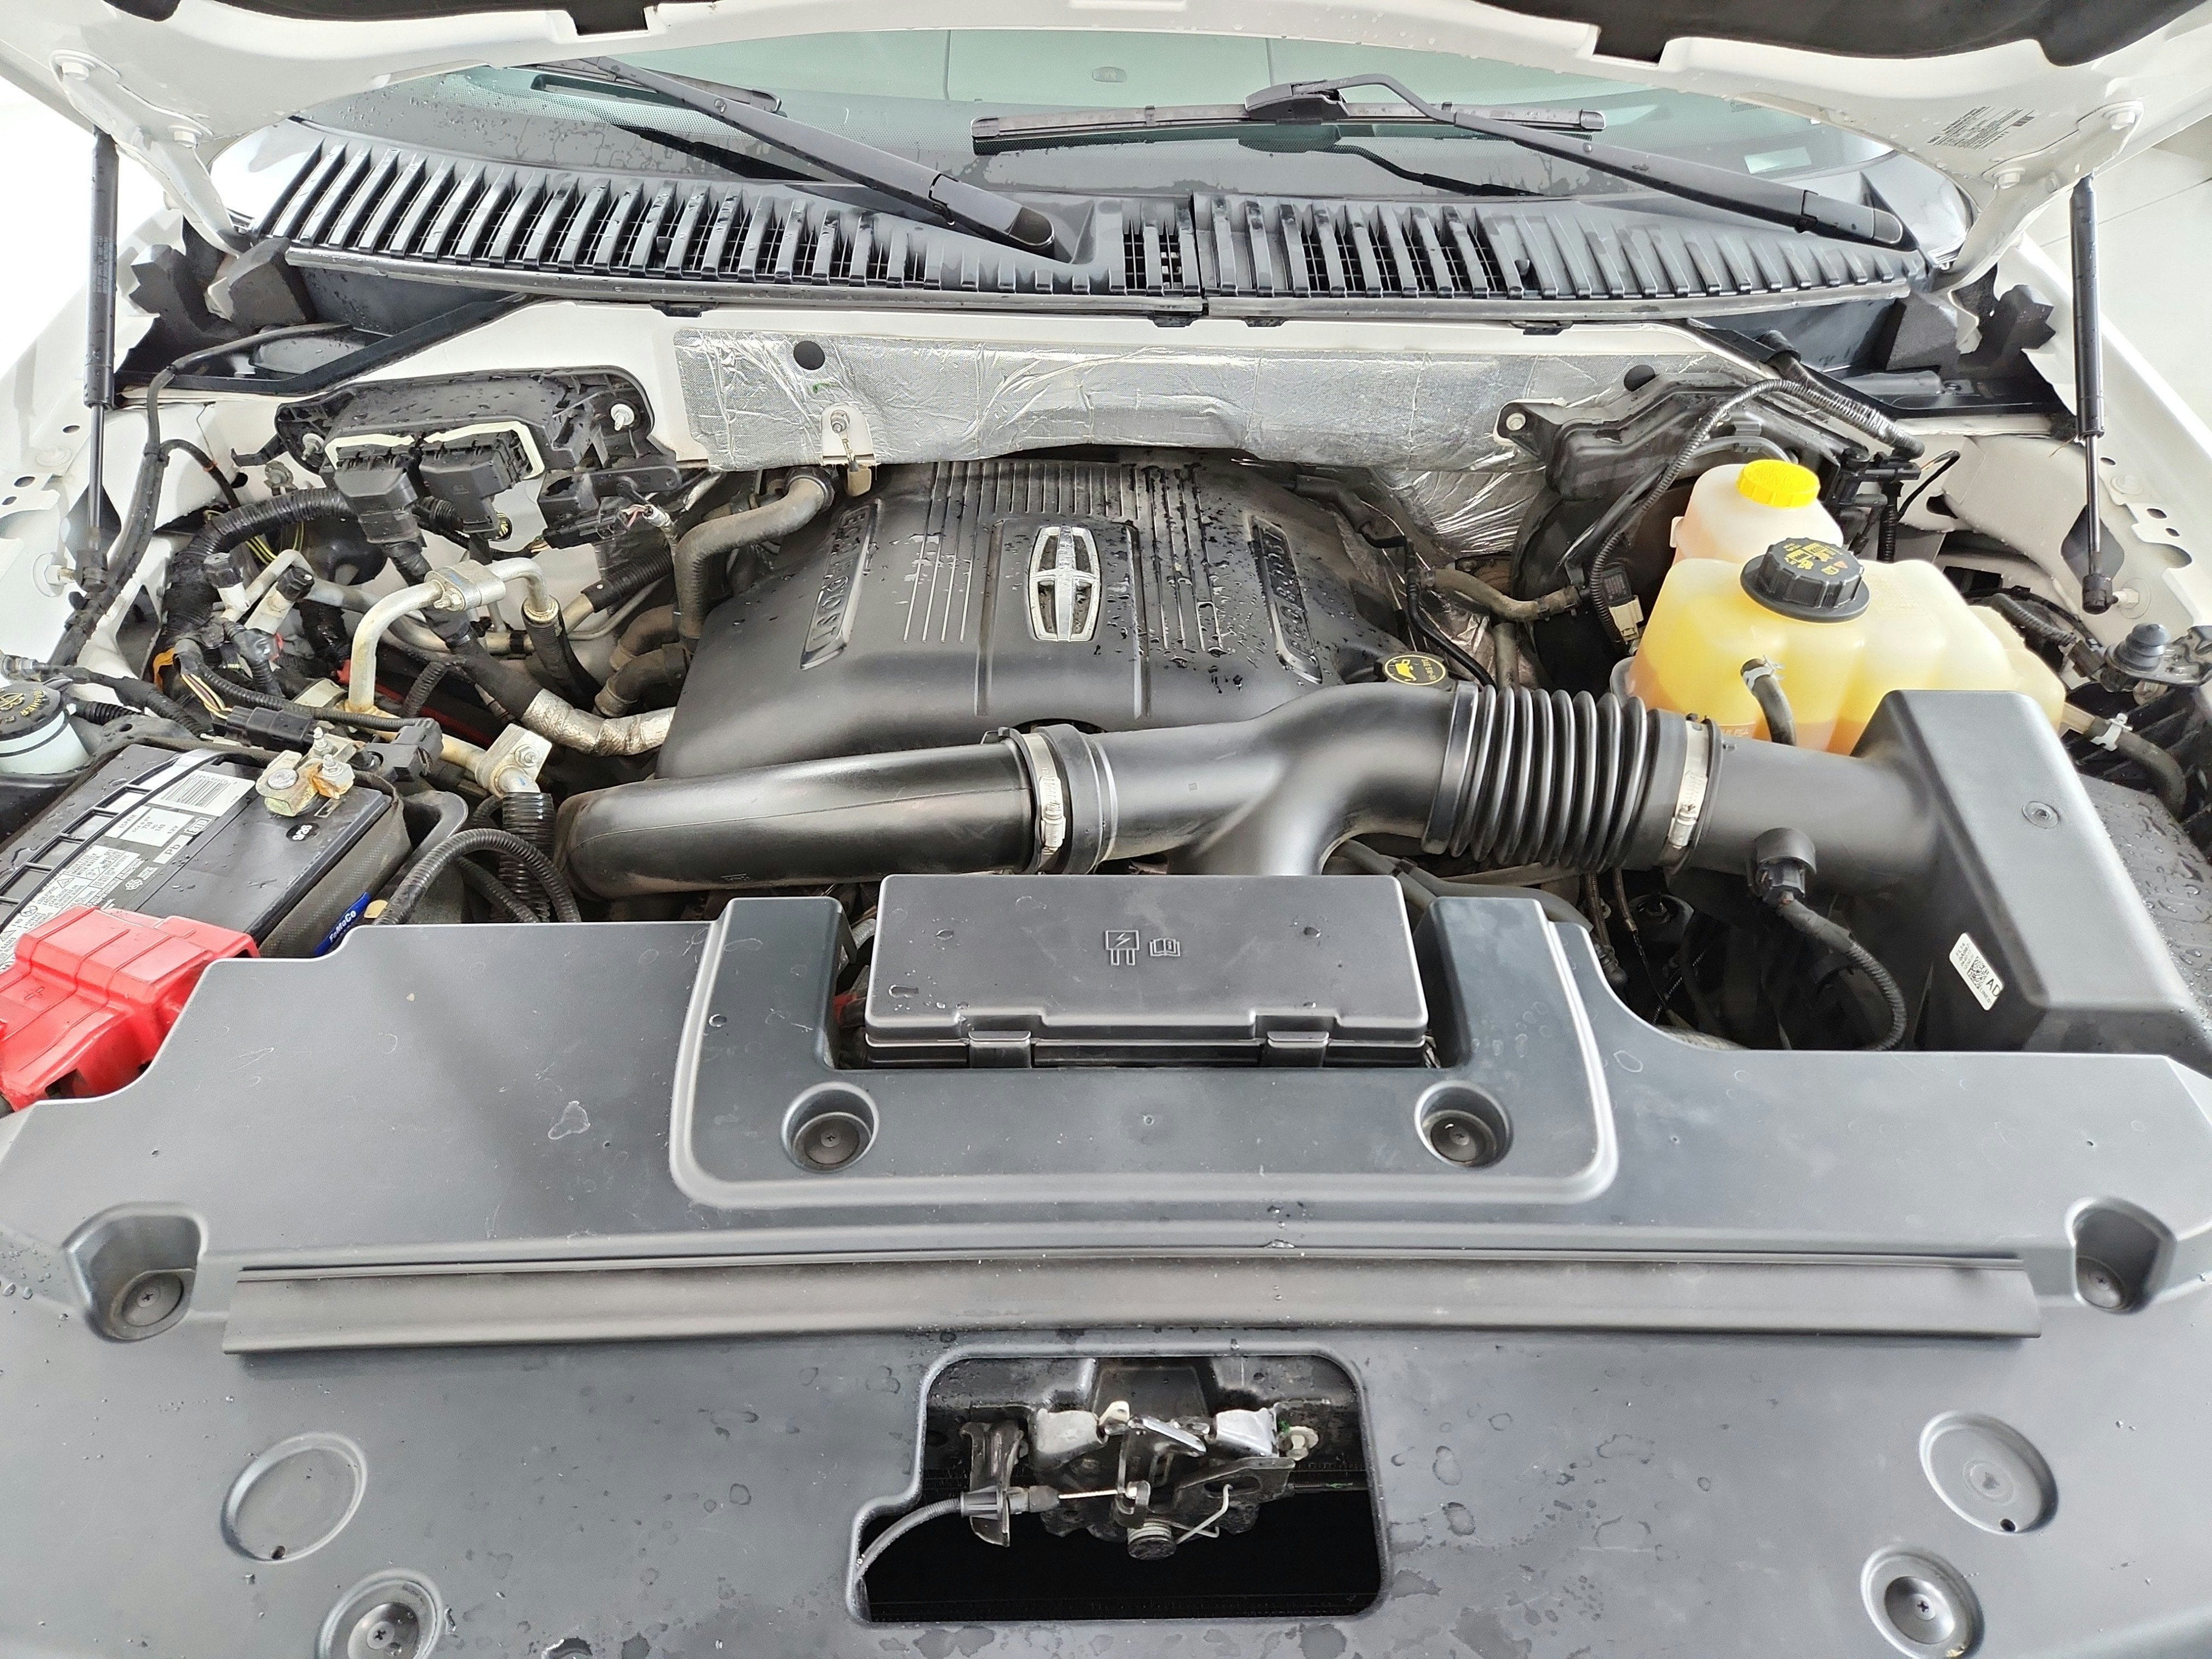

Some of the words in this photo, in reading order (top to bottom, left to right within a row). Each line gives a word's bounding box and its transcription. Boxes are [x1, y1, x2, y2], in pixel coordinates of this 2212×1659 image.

[164, 844, 180, 855] Pb
[329, 910, 357, 943] FoMoCo
[1986, 978, 2001, 997] AD
